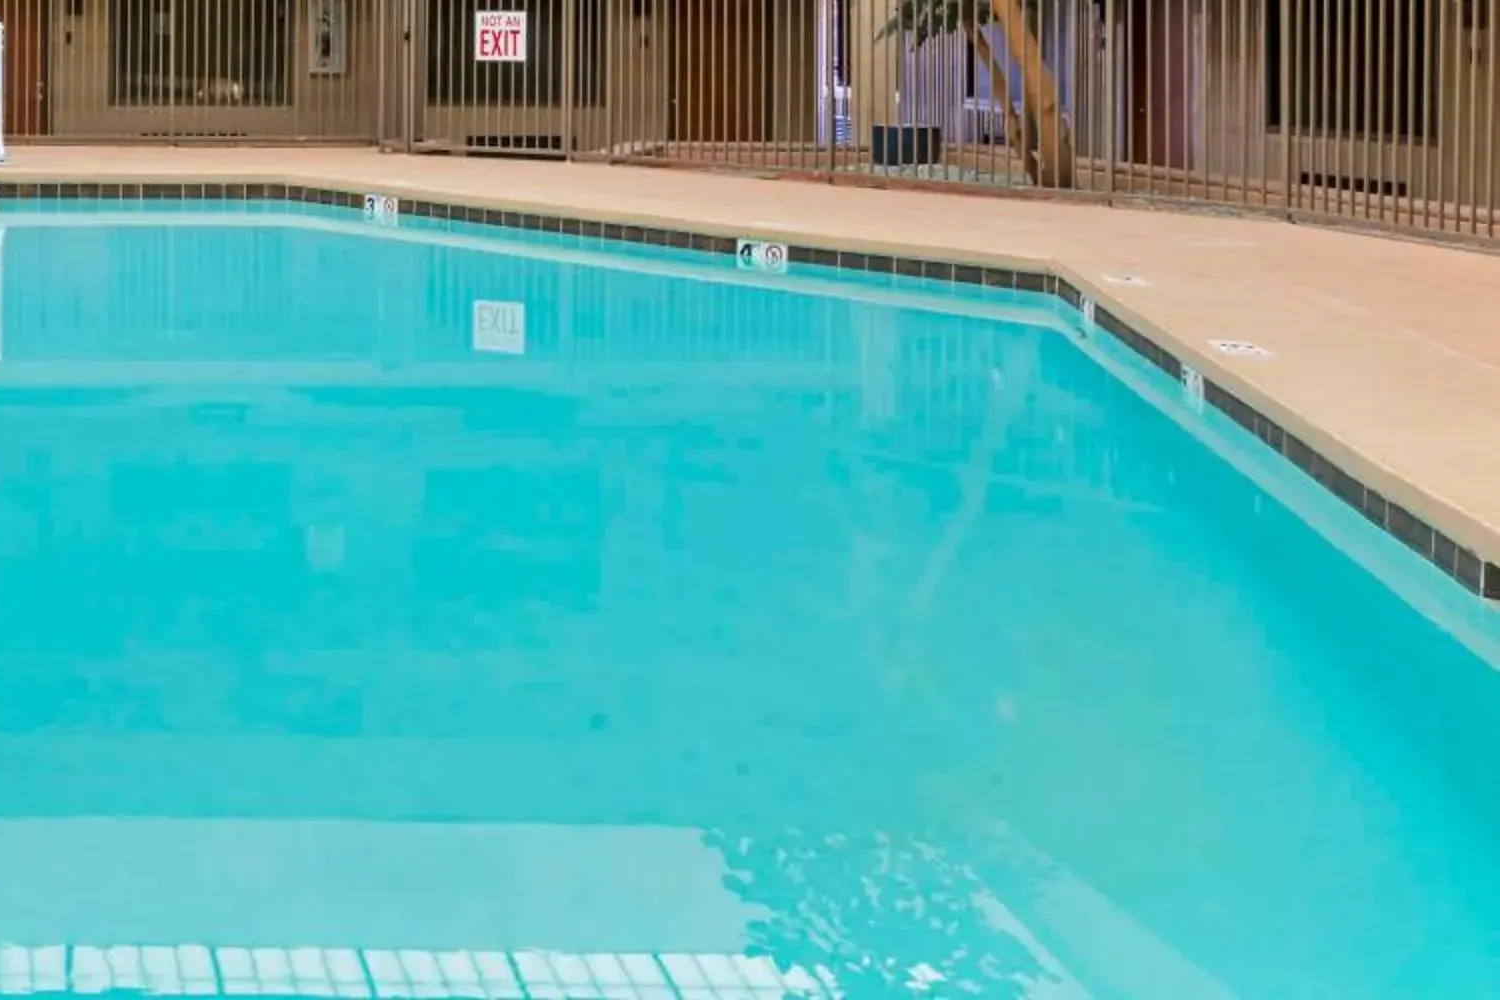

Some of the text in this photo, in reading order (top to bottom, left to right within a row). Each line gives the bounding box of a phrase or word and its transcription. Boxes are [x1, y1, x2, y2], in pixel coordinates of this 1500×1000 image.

[480, 15, 520, 27] NOT AN
[480, 29, 521, 57] EXIT
